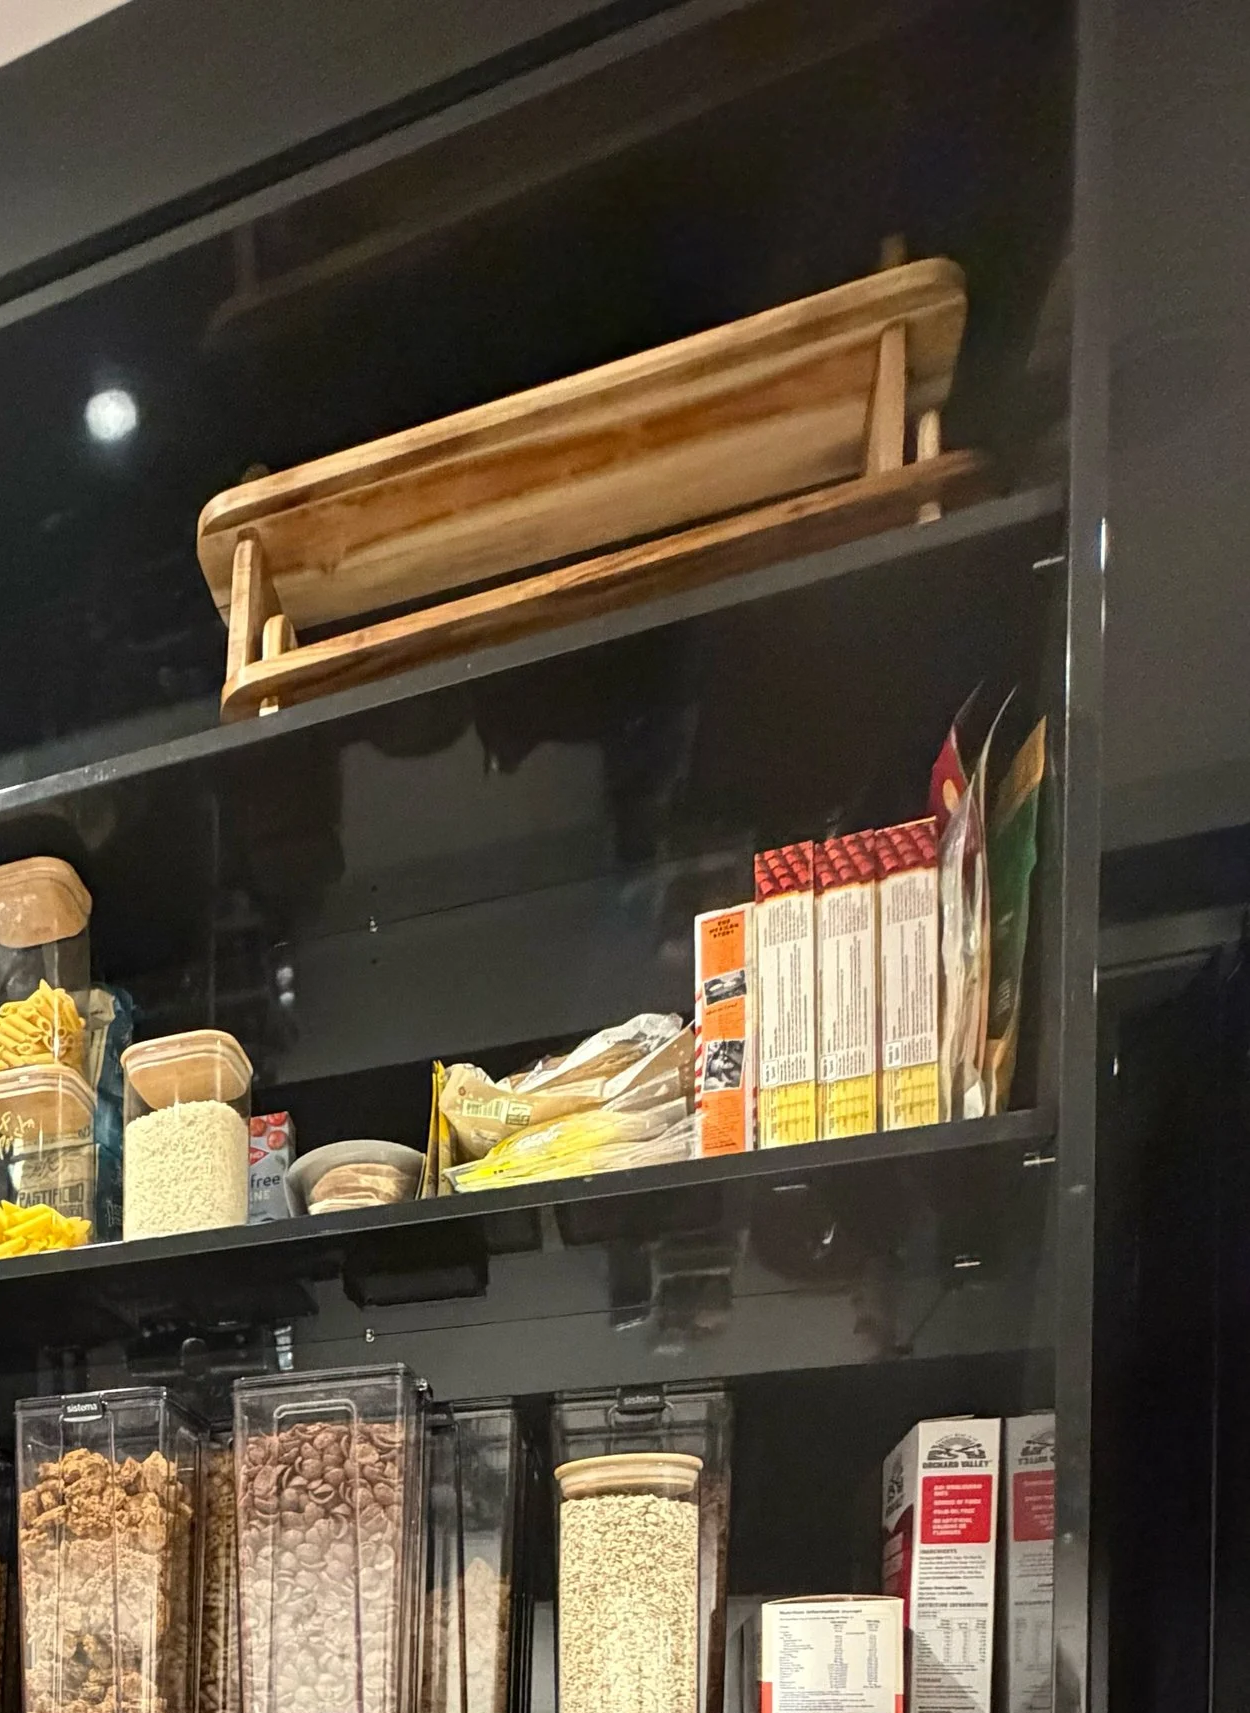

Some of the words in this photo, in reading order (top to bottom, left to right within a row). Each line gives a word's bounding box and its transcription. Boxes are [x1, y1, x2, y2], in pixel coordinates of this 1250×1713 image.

[251, 1173, 281, 1189] free
[66, 1403, 97, 1413] sistema
[961, 1459, 990, 1468] VALLEY
